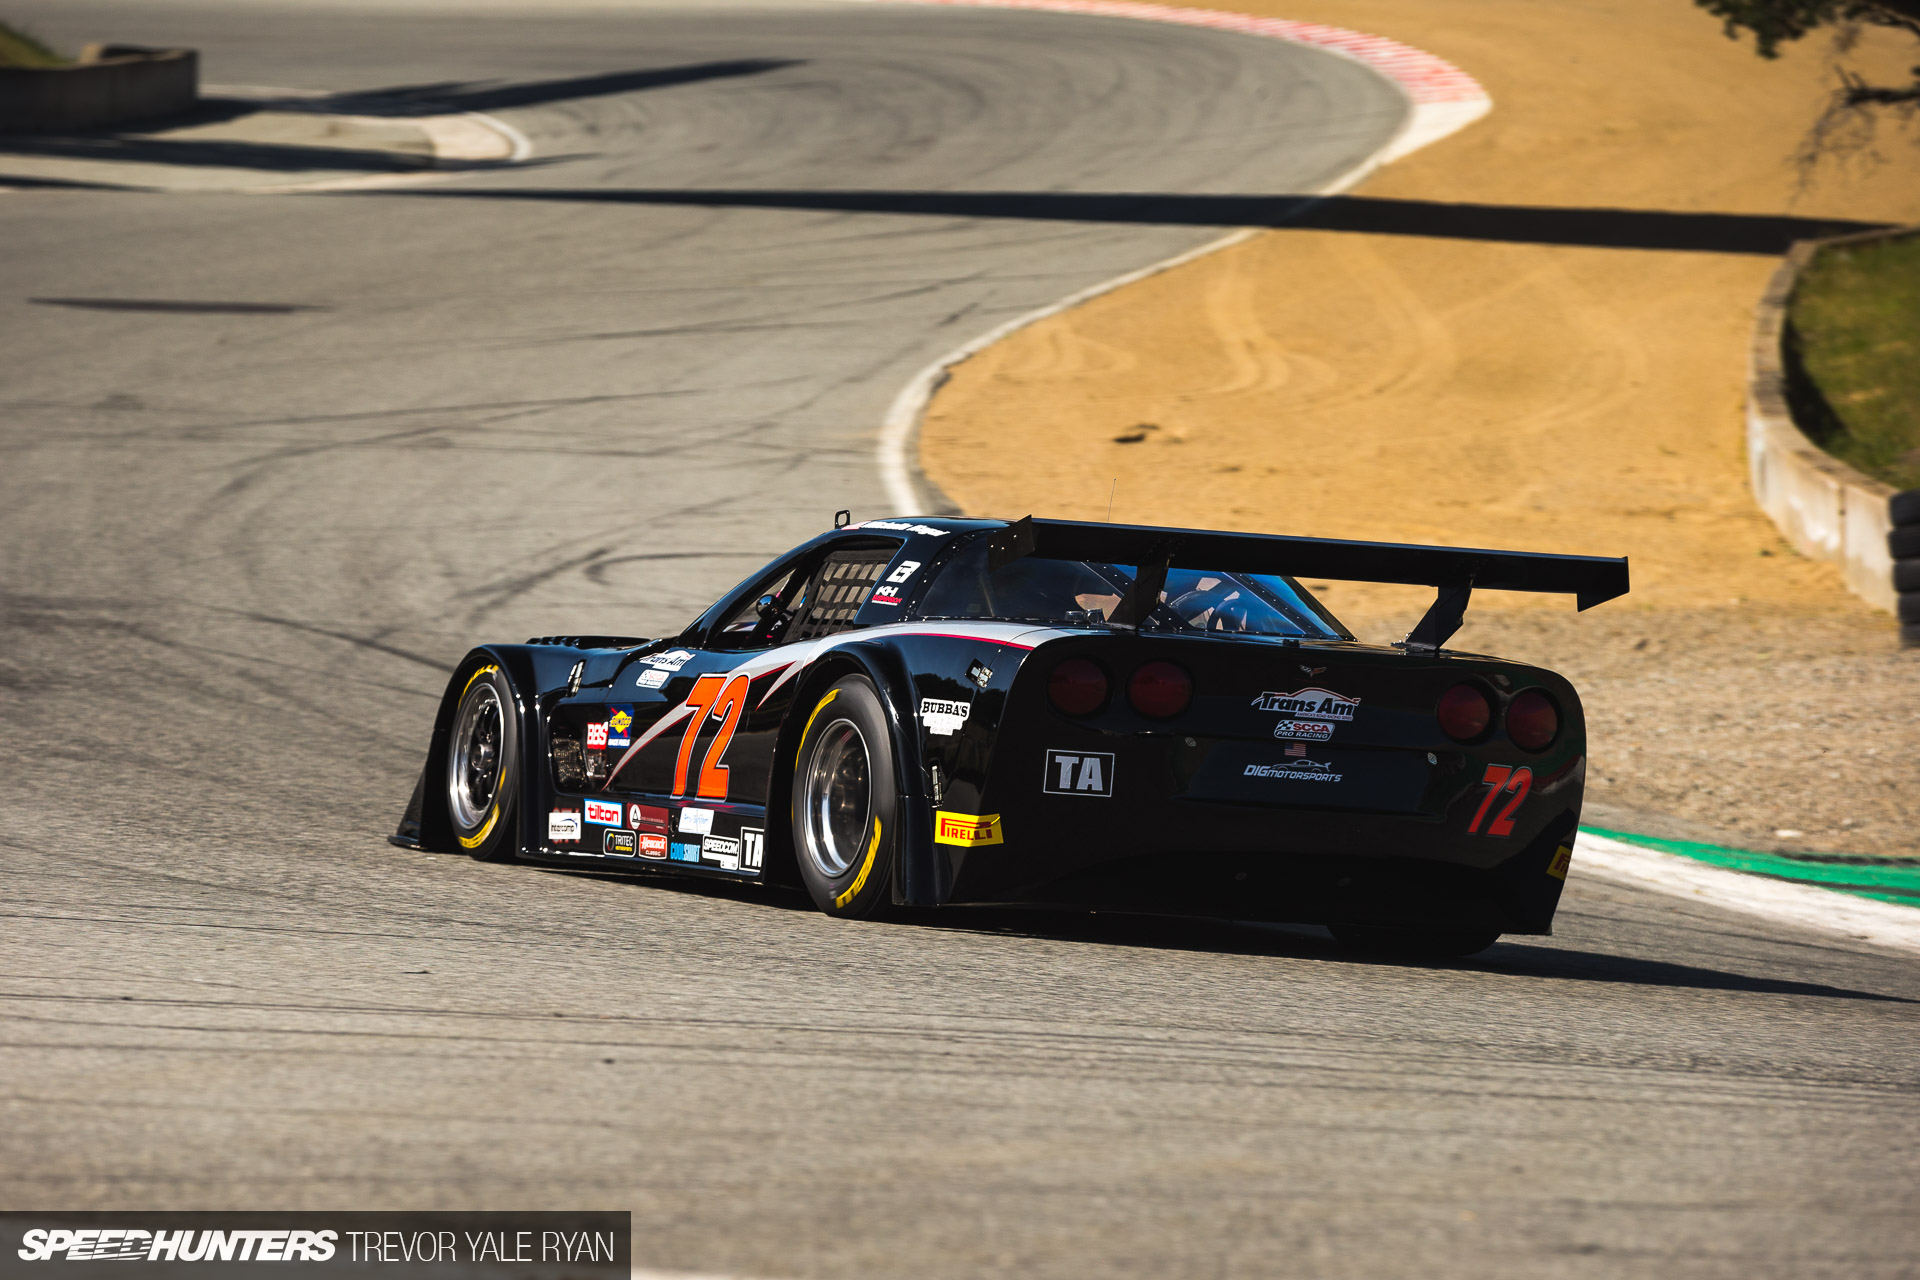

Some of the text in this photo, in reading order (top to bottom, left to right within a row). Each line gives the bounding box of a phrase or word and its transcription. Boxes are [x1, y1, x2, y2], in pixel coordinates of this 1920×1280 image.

[922, 701, 968, 717] BUBBA'S
[1259, 691, 1353, 716] Trans Am
[587, 721, 608, 745] BBS
[670, 672, 750, 802] 72
[1293, 723, 1330, 732] SCCA
[1055, 755, 1103, 791] TA
[588, 804, 619, 822] tilton
[1467, 763, 1533, 839] 72
[615, 835, 633, 847] TRITEC
[940, 818, 993, 841] PIRELLI
[744, 833, 763, 867] TA
